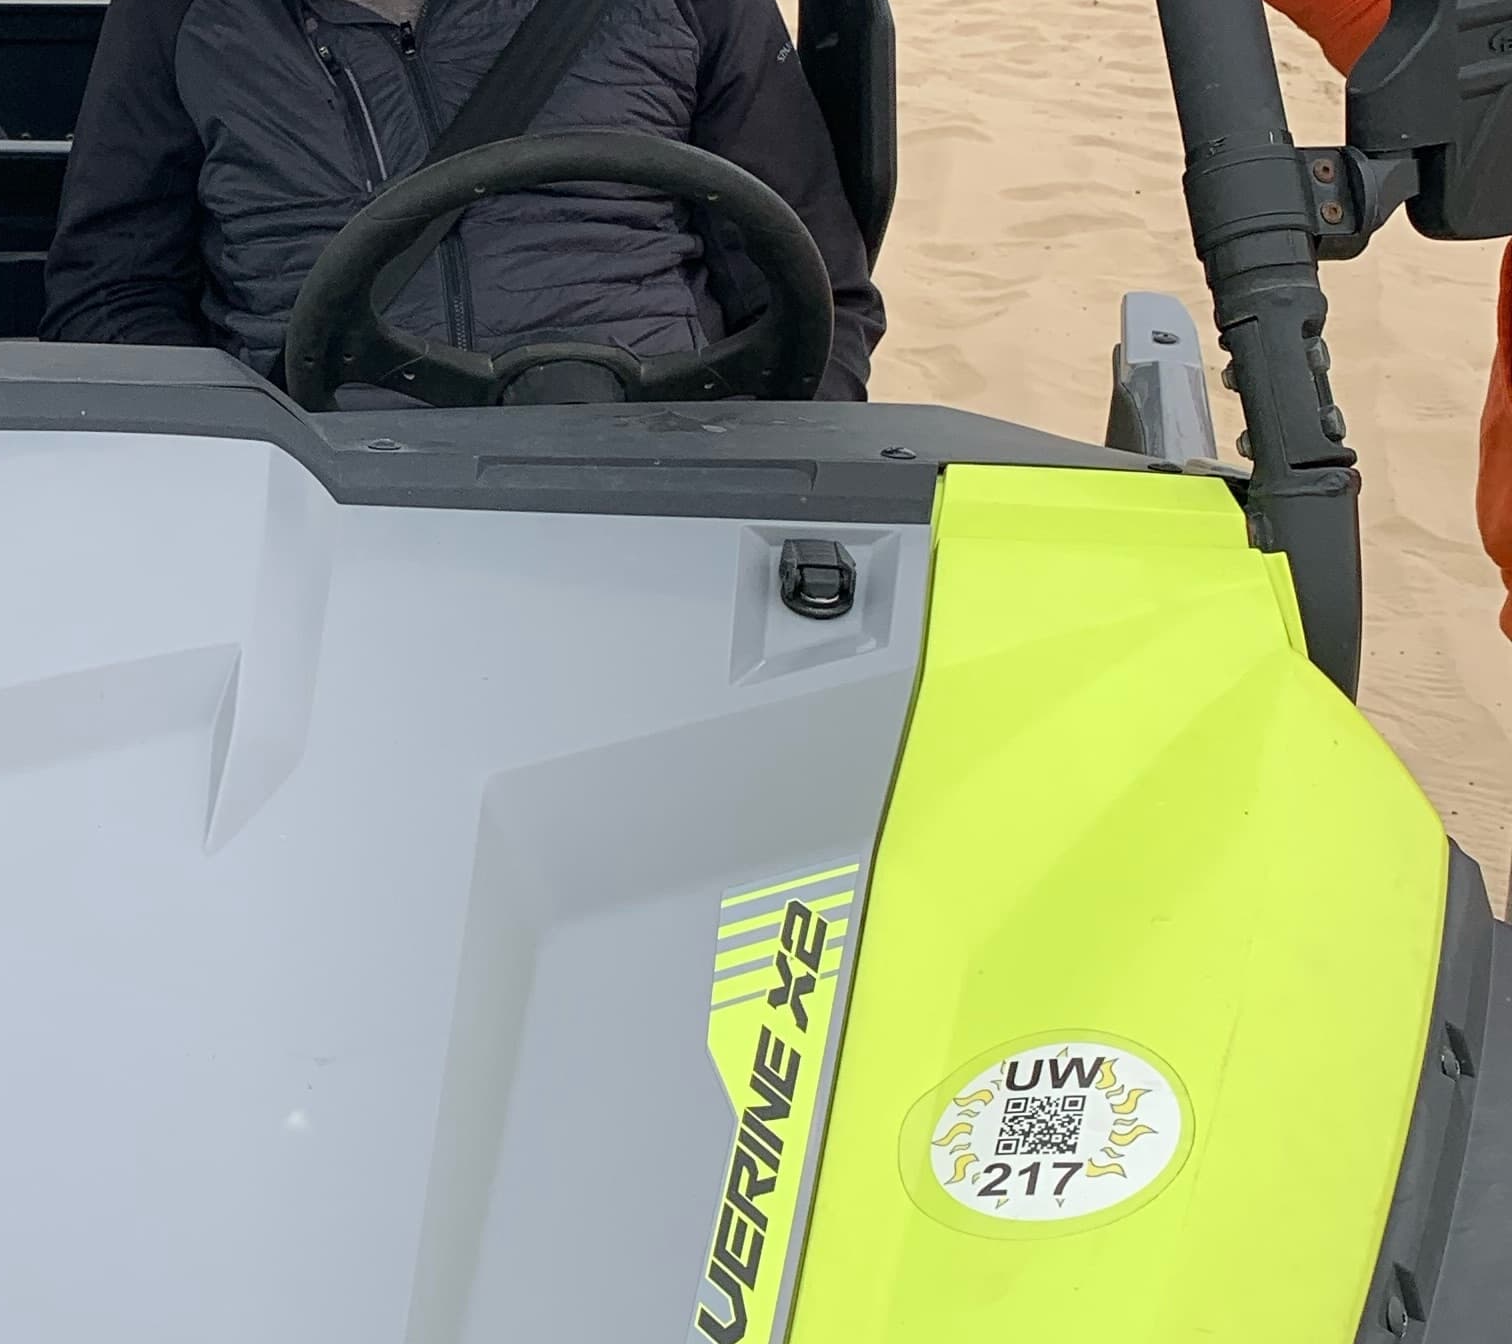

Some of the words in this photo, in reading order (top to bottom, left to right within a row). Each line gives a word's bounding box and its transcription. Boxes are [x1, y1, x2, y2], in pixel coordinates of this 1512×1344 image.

[767, 899, 828, 1033] X2
[1004, 1057, 1106, 1092] UW
[977, 1162, 1084, 1197] 217
